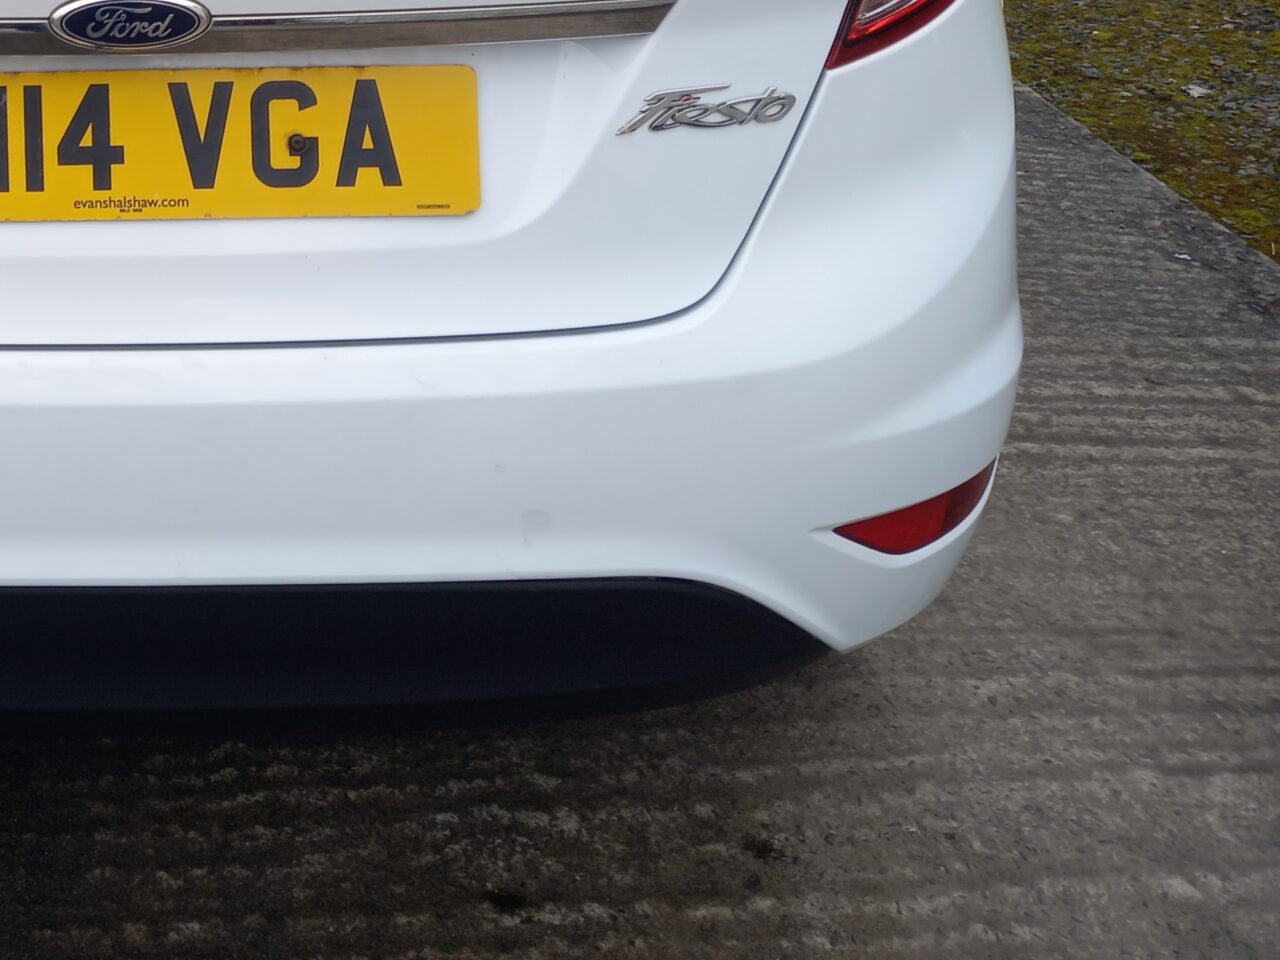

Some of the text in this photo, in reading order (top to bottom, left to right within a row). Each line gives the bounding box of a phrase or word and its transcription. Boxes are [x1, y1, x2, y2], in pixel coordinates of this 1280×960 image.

[86, 6, 175, 39] Ford
[615, 83, 797, 136] Fiesta
[167, 79, 403, 190] VGA
[73, 196, 189, 209] evanshalshaw.com
